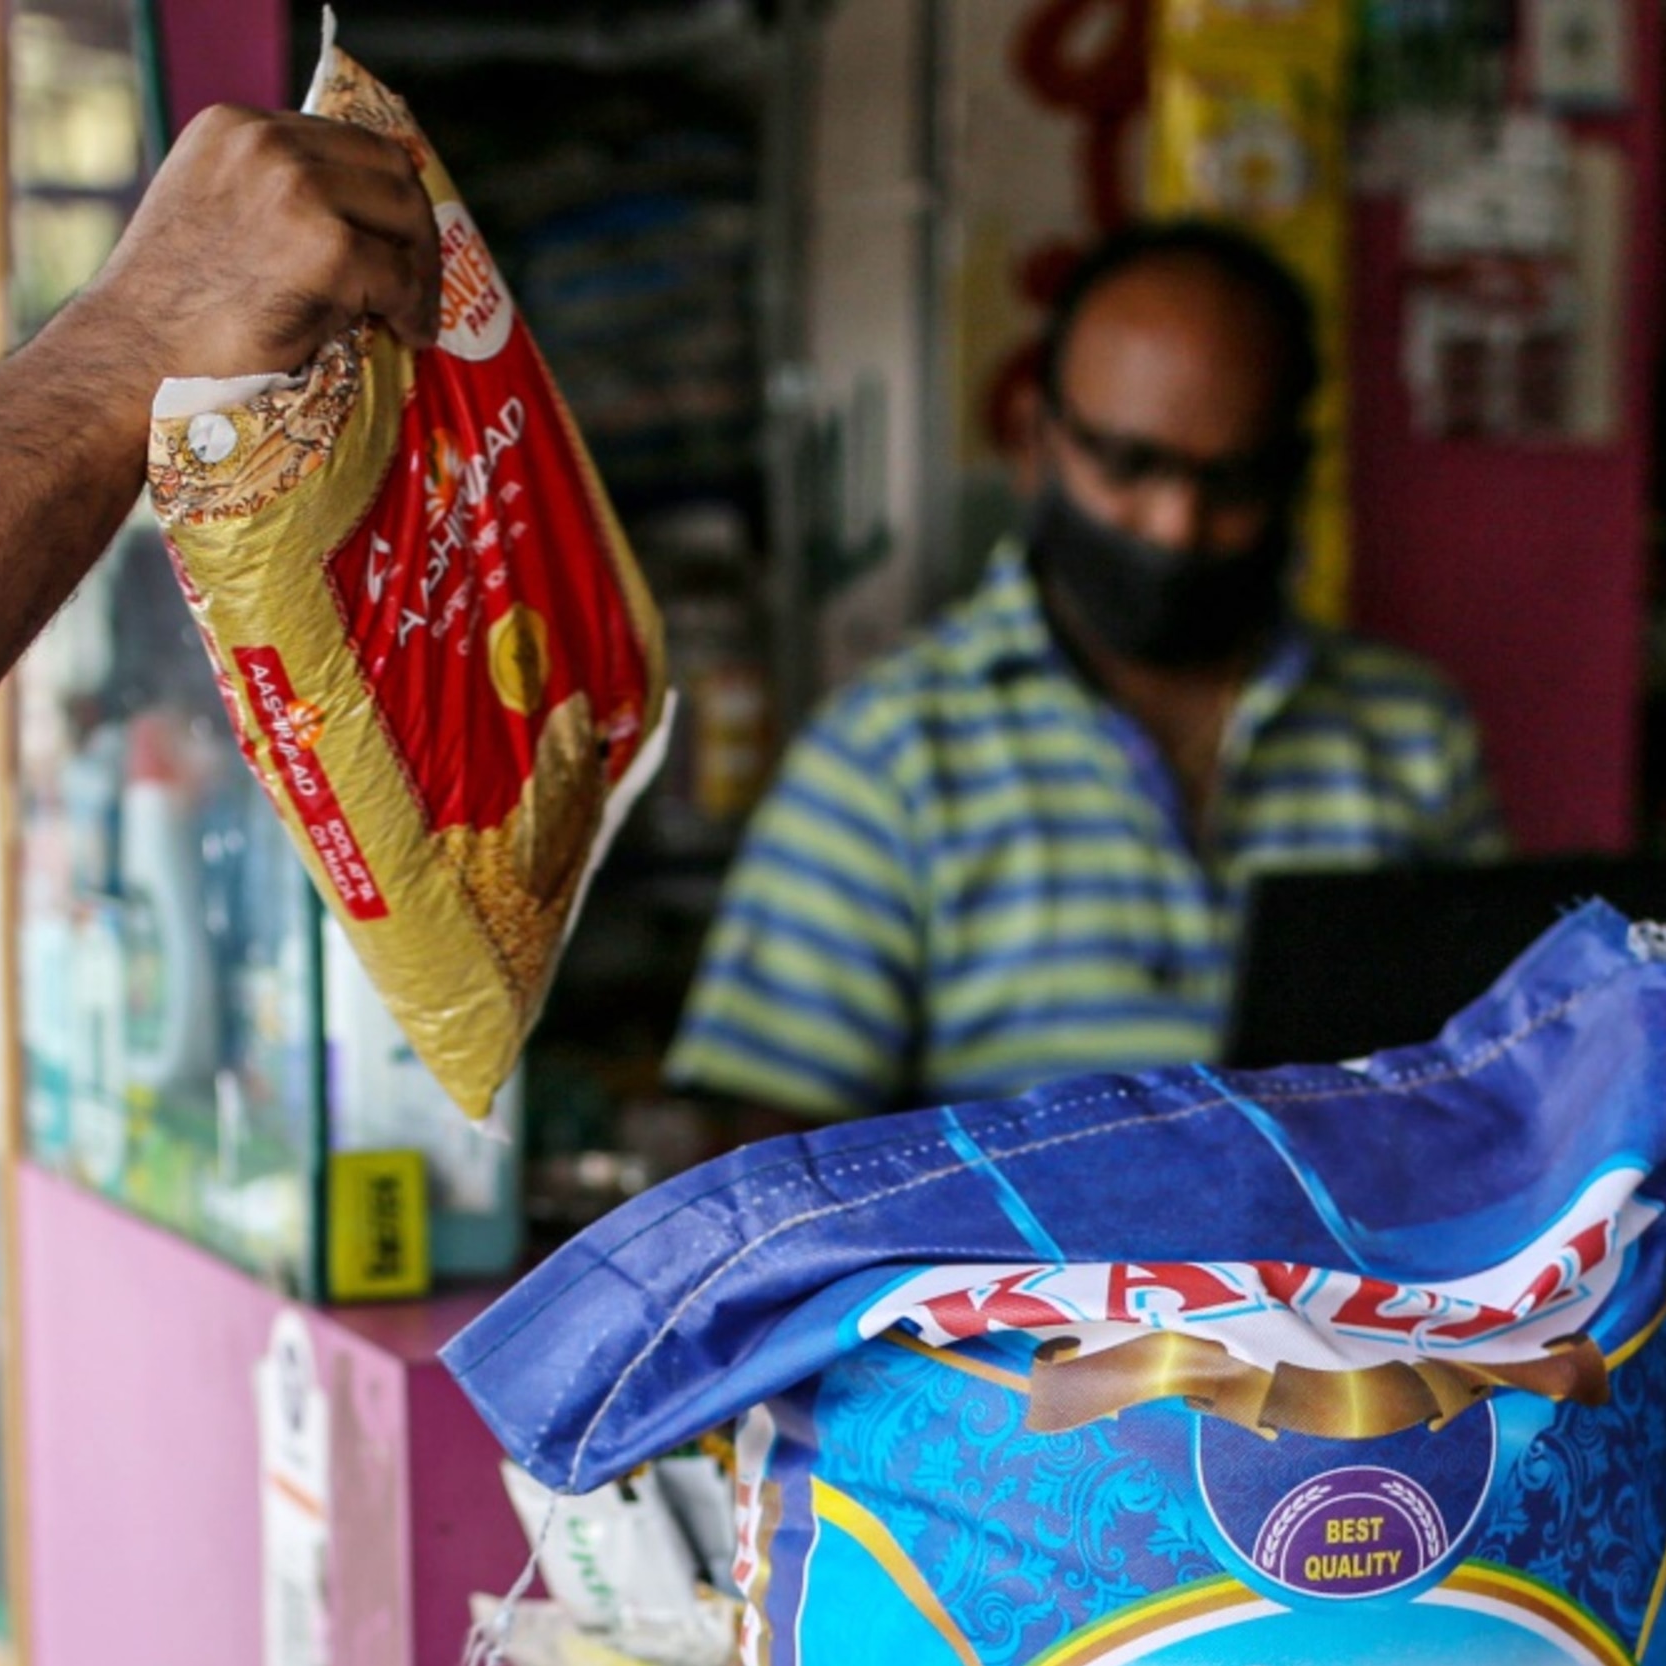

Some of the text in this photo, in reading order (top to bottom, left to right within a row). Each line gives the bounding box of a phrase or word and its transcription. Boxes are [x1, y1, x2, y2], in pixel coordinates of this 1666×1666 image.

[465, 284, 502, 338] PACK
[1326, 1517, 1384, 1543] BEST
[1304, 1550, 1402, 1581] QUALITY
